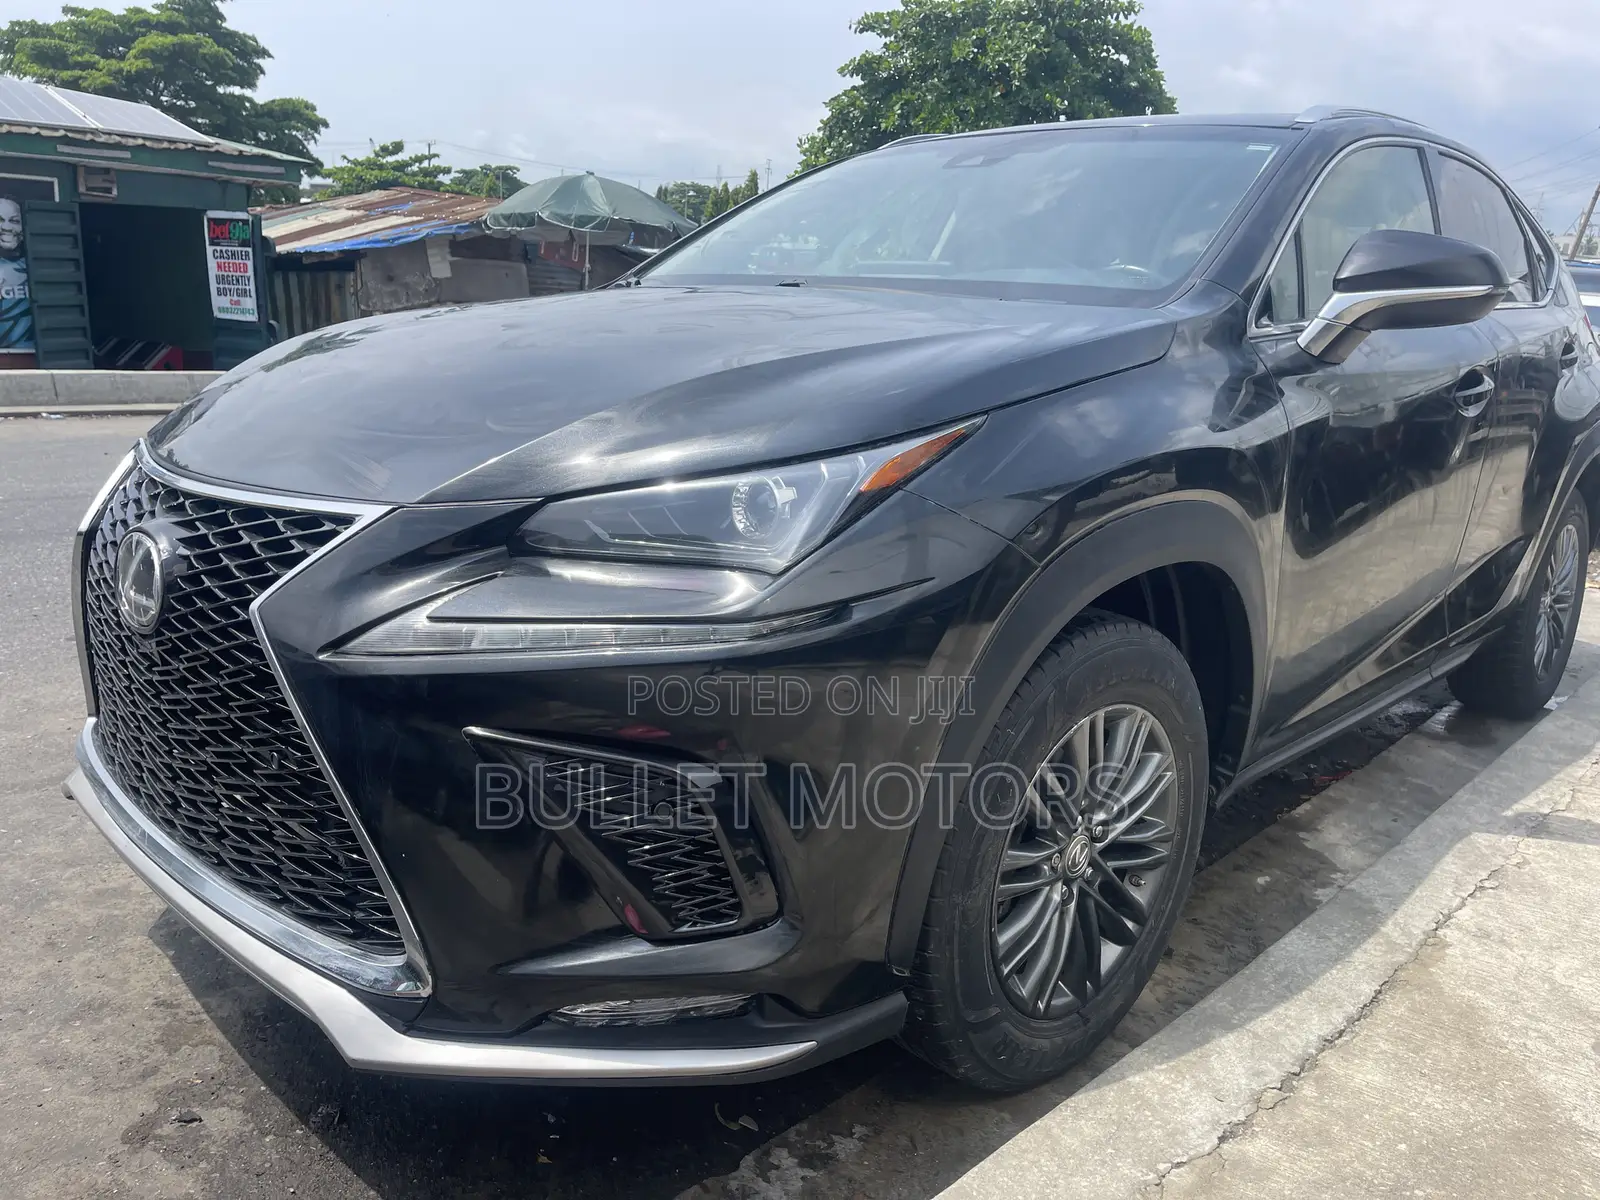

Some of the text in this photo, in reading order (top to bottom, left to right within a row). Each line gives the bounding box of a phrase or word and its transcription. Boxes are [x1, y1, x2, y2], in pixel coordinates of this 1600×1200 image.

[212, 248, 251, 261] CASHIER
[216, 261, 249, 274] NEEDED
[215, 273, 251, 287] URGENTLY
[216, 286, 253, 298] BOY/GIRL
